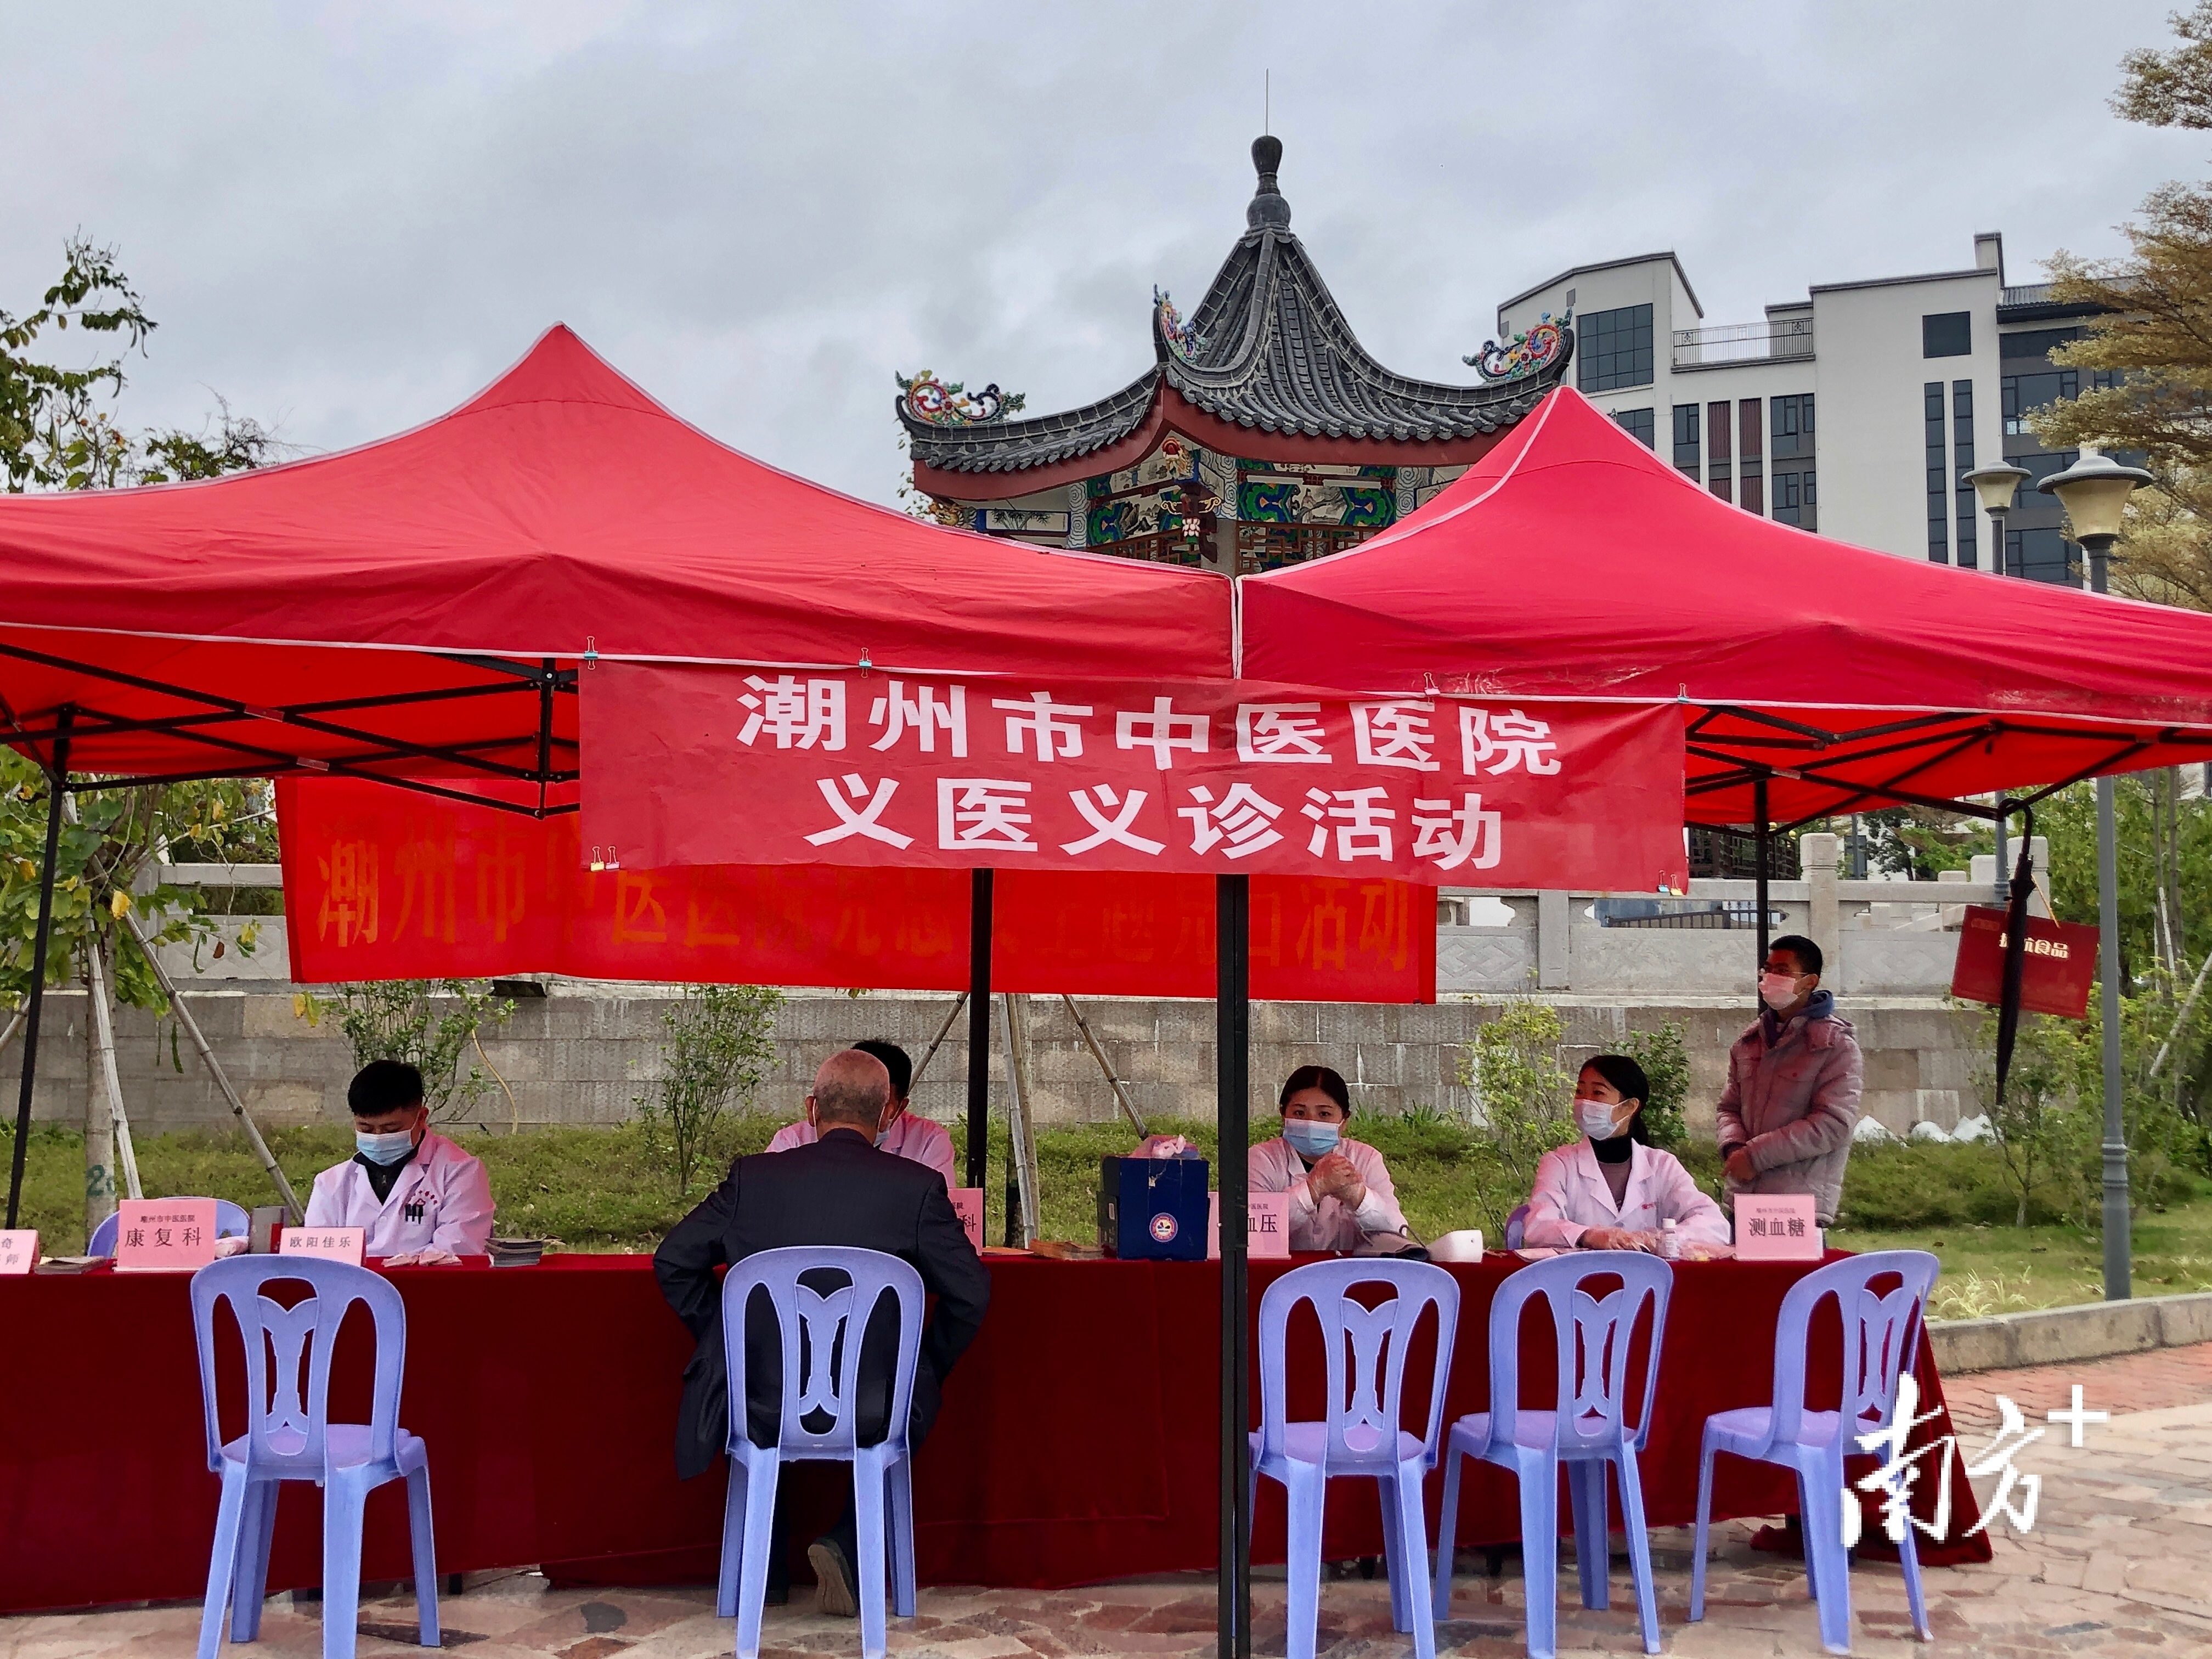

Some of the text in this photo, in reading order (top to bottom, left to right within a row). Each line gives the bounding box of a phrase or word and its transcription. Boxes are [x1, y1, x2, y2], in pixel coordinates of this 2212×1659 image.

[736, 674, 1561, 776] 潮州市中医医院
[803, 772, 1502, 871] 义医义诊活动
[125, 1227, 201, 1247] 康复科
[1748, 1217, 1805, 1237] 测血糖
[290, 1236, 351, 1248] 欧阳佳乐
